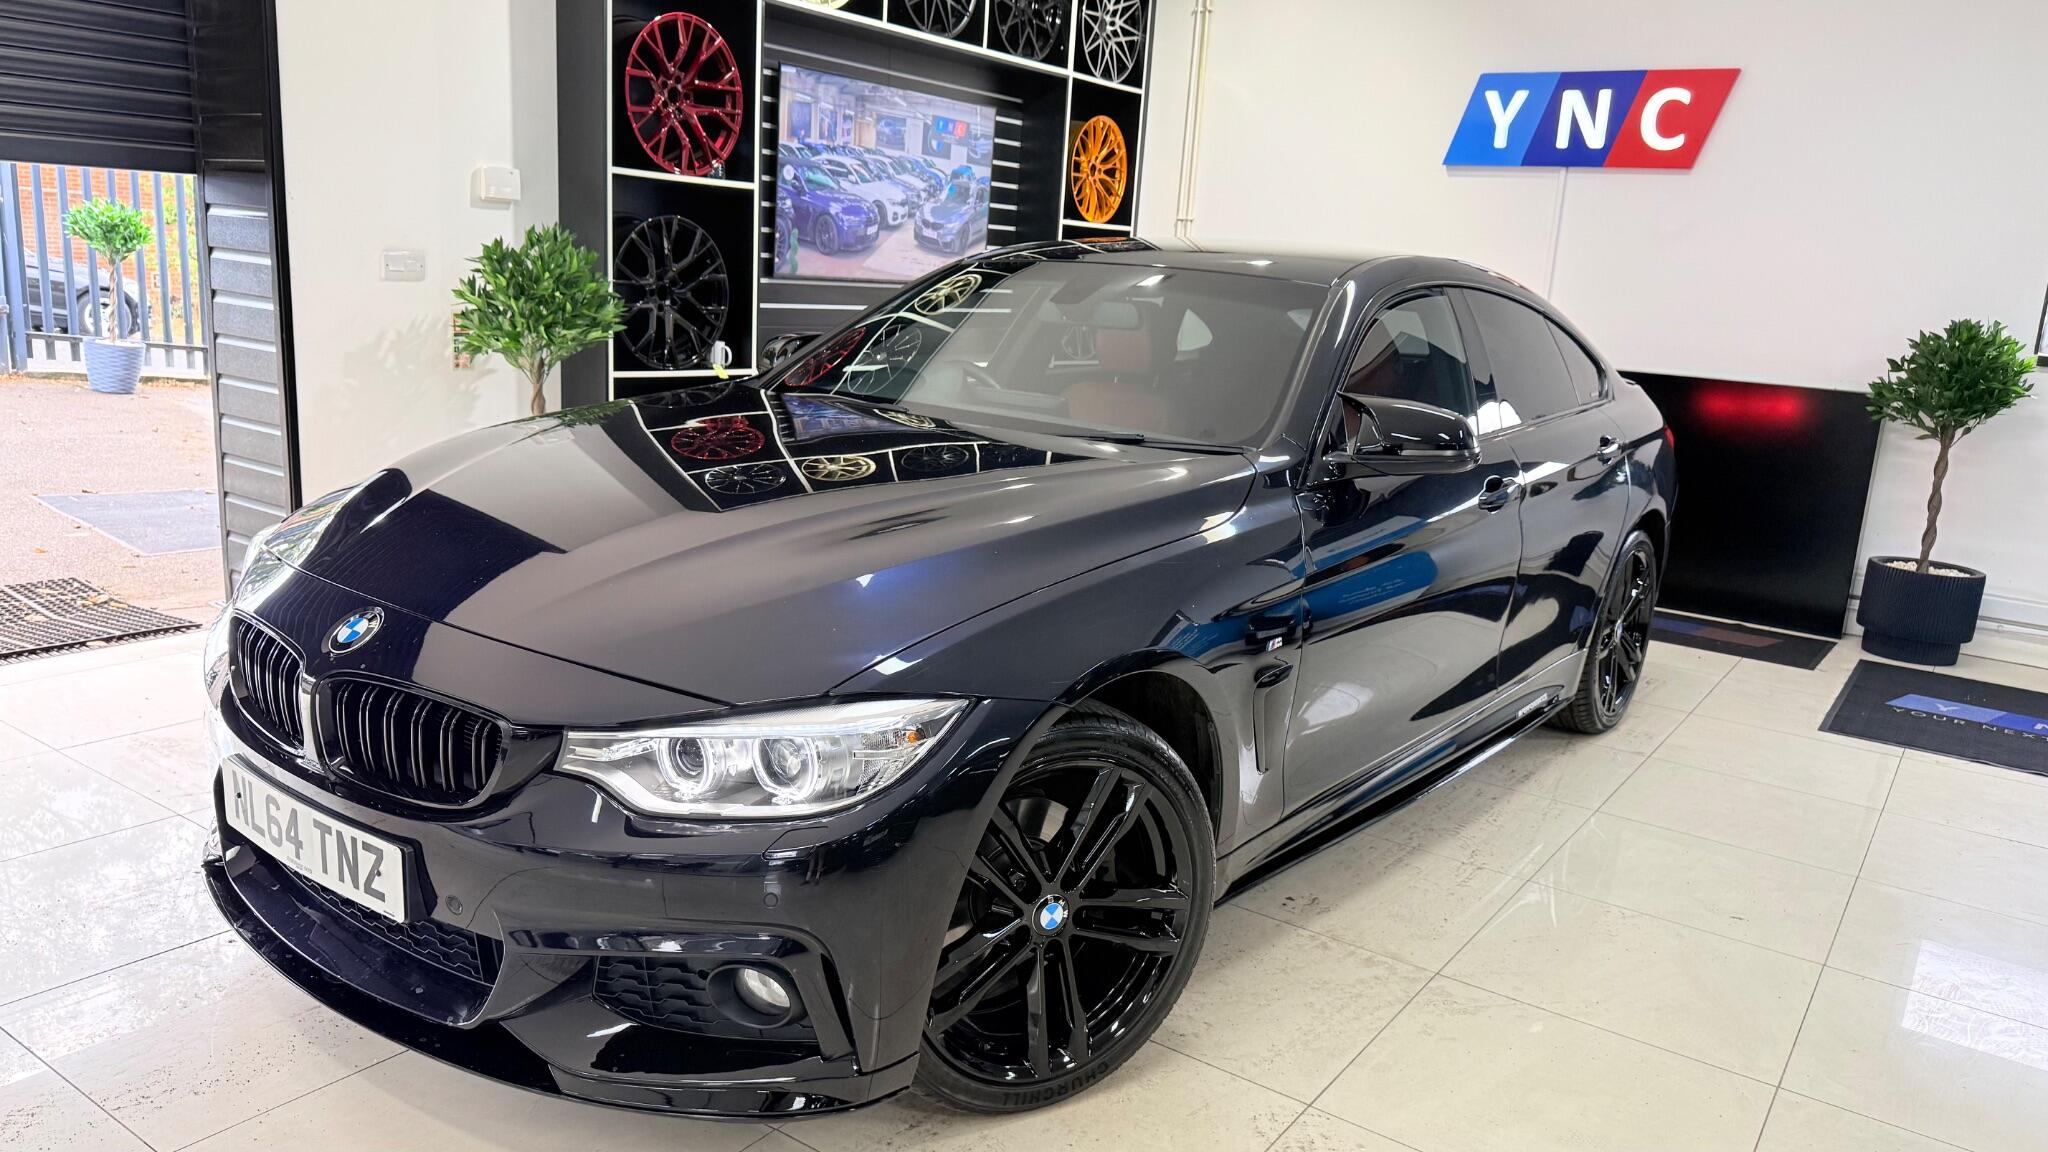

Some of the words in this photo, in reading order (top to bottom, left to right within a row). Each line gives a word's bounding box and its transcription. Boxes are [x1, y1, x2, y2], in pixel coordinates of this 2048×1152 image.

[1484, 87, 1692, 151] YNC
[1890, 707, 1966, 725] YOUR
[232, 769, 304, 861] NL64
[312, 817, 387, 904] TNZ
[1003, 1060, 1109, 1106] CHURCHILL
